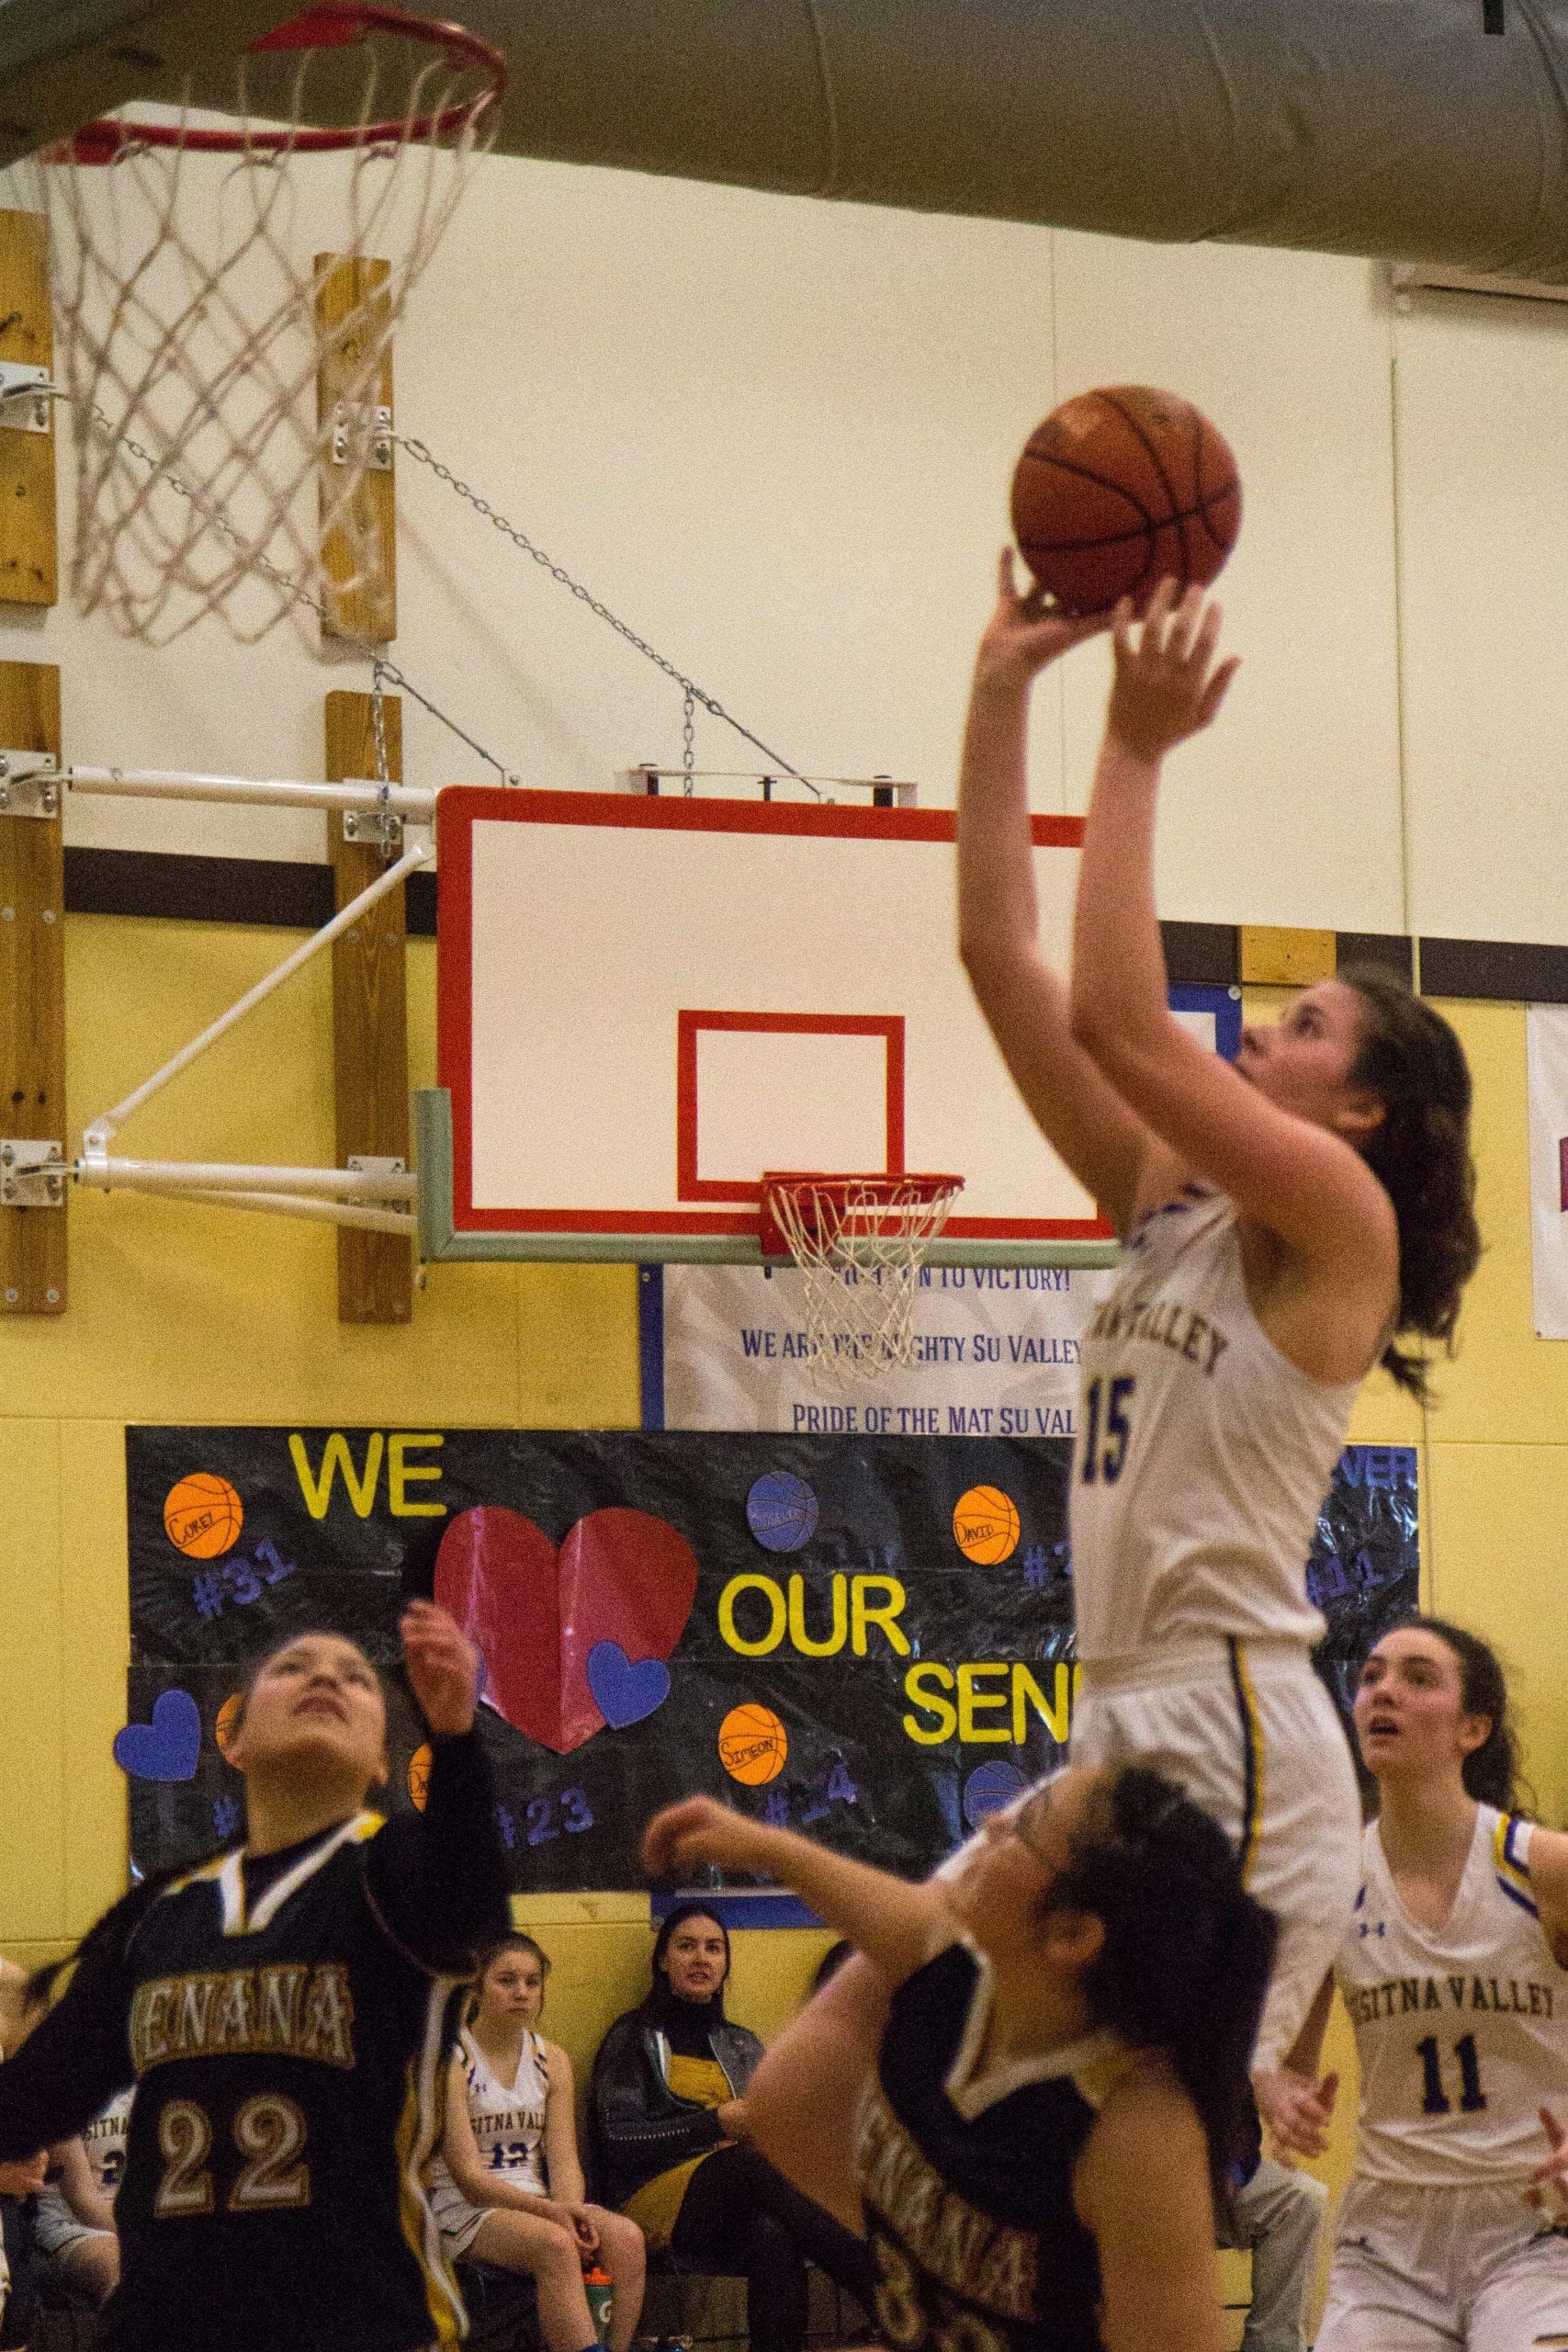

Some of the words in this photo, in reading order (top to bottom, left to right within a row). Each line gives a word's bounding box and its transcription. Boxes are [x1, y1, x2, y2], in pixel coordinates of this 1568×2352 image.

[973, 1267, 1071, 1292] VICTORY!
[740, 1329, 777, 1358] WE
[973, 1334, 1001, 1363] SU
[793, 1404, 858, 1433] PRIDE
[864, 1407, 892, 1433] OF
[897, 1408, 940, 1434] THE
[948, 1407, 994, 1435] MAT
[999, 1408, 1030, 1435] SU
[1082, 1375, 1135, 1485] 15
[288, 1433, 447, 1520] WE
[954, 1521, 994, 1545] DAVID
[718, 1573, 910, 1657] OUR
[720, 1738, 773, 1766] SIMEON
[1416, 2034, 1486, 2113] 11
[154, 2093, 310, 2218] 22
